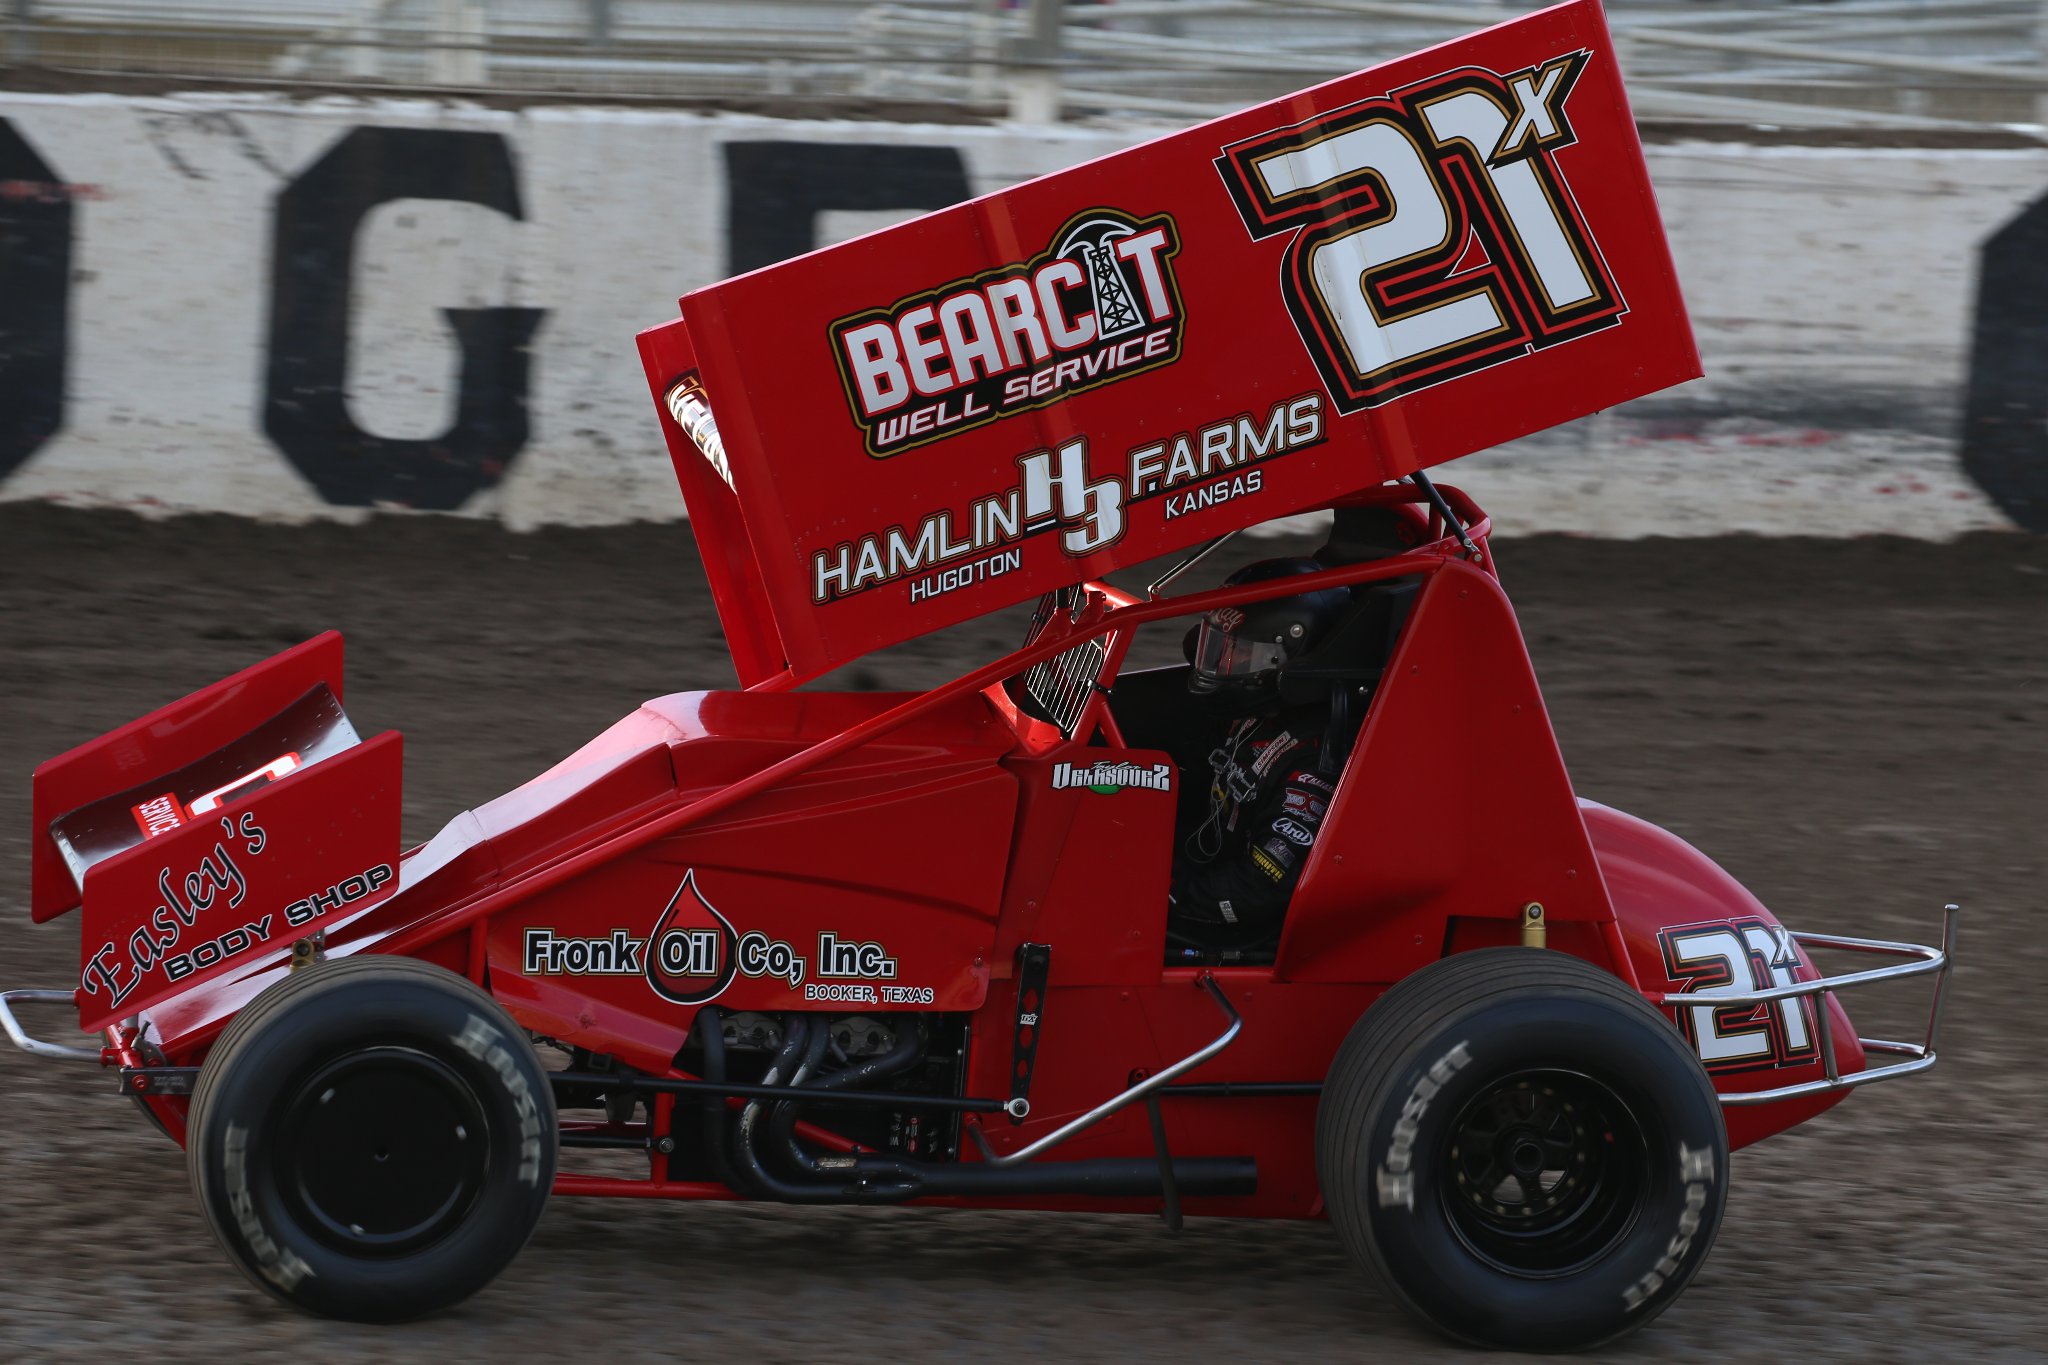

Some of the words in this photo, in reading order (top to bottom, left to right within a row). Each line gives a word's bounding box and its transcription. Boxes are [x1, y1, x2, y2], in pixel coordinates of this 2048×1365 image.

[876, 392, 989, 446] WELL
[1004, 328, 1172, 406] SERVICE
[815, 491, 1020, 600] HAMLIN
[1131, 395, 1322, 497] FARMS
[911, 549, 1021, 602] HUGOTON
[1165, 471, 1263, 519] KANSAS
[138, 796, 181, 836] SERVICE
[83, 811, 266, 1009] Easley's
[164, 914, 273, 982] BODY
[283, 863, 392, 927] SHOP
[523, 928, 643, 975] Fronk
[659, 929, 720, 977] Oil
[817, 931, 897, 979] Inc.
[805, 984, 879, 1004] BOOKER,
[880, 986, 935, 1004] TEXAS
